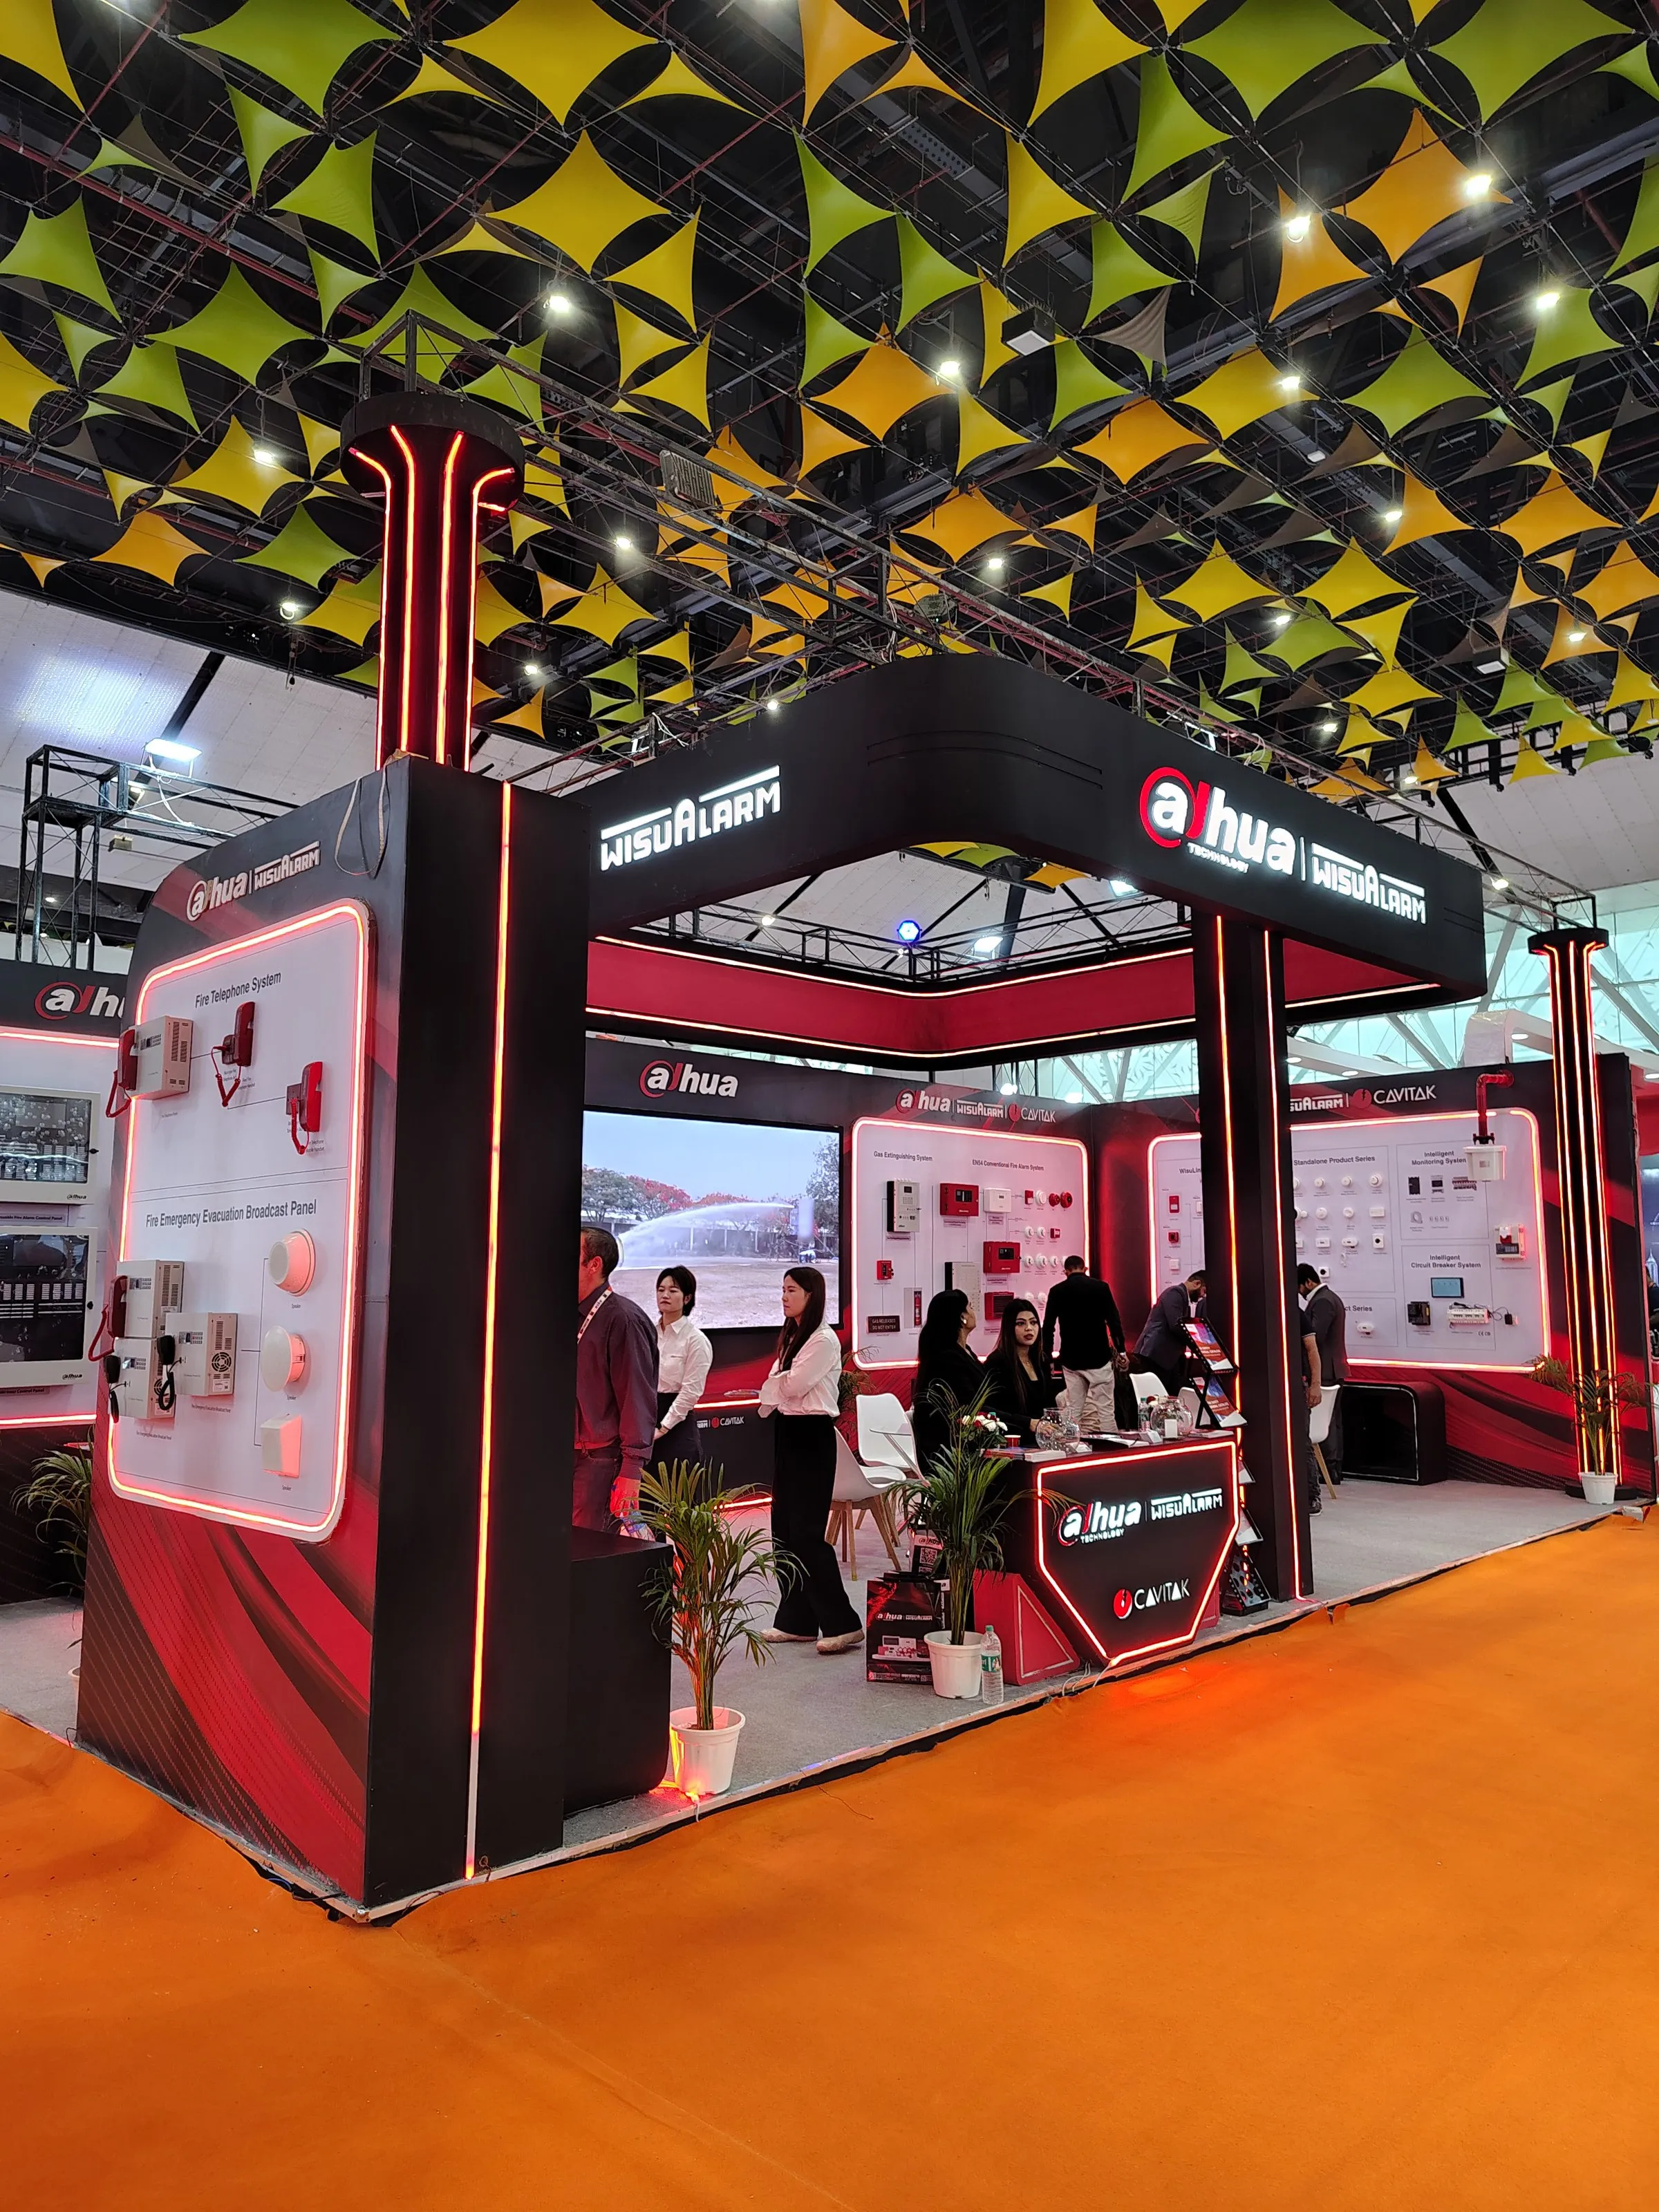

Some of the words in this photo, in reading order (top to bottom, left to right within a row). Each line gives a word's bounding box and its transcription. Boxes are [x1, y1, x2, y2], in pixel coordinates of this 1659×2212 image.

[600, 765, 781, 871] WISUALARM
[254, 841, 321, 890] WISUALARM
[1187, 842, 1249, 873] TECHNOLOGY
[1311, 843, 1426, 924] WISUALARM
[195, 993, 209, 1009] Fire
[211, 982, 250, 1003] Telephone
[252, 972, 281, 993] System
[1374, 1085, 1437, 1104] CAVITAK
[957, 1099, 1003, 1118] WISUALARM
[1021, 1107, 1056, 1123] CAVITAK
[884, 1152, 916, 1161] Extinguishing
[146, 1214, 158, 1228] Fire
[160, 1212, 200, 1228] Emergency
[203, 1206, 244, 1223] Evacuation
[246, 1201, 288, 1219] Broadcast
[290, 1199, 317, 1216] Panel
[720, 1416, 744, 1425] CAVITAK
[1151, 1488, 1223, 1521] WISUALARM
[1080, 1528, 1125, 1544] TECHNOLOGY
[1134, 1578, 1190, 1610] CAVITAK
